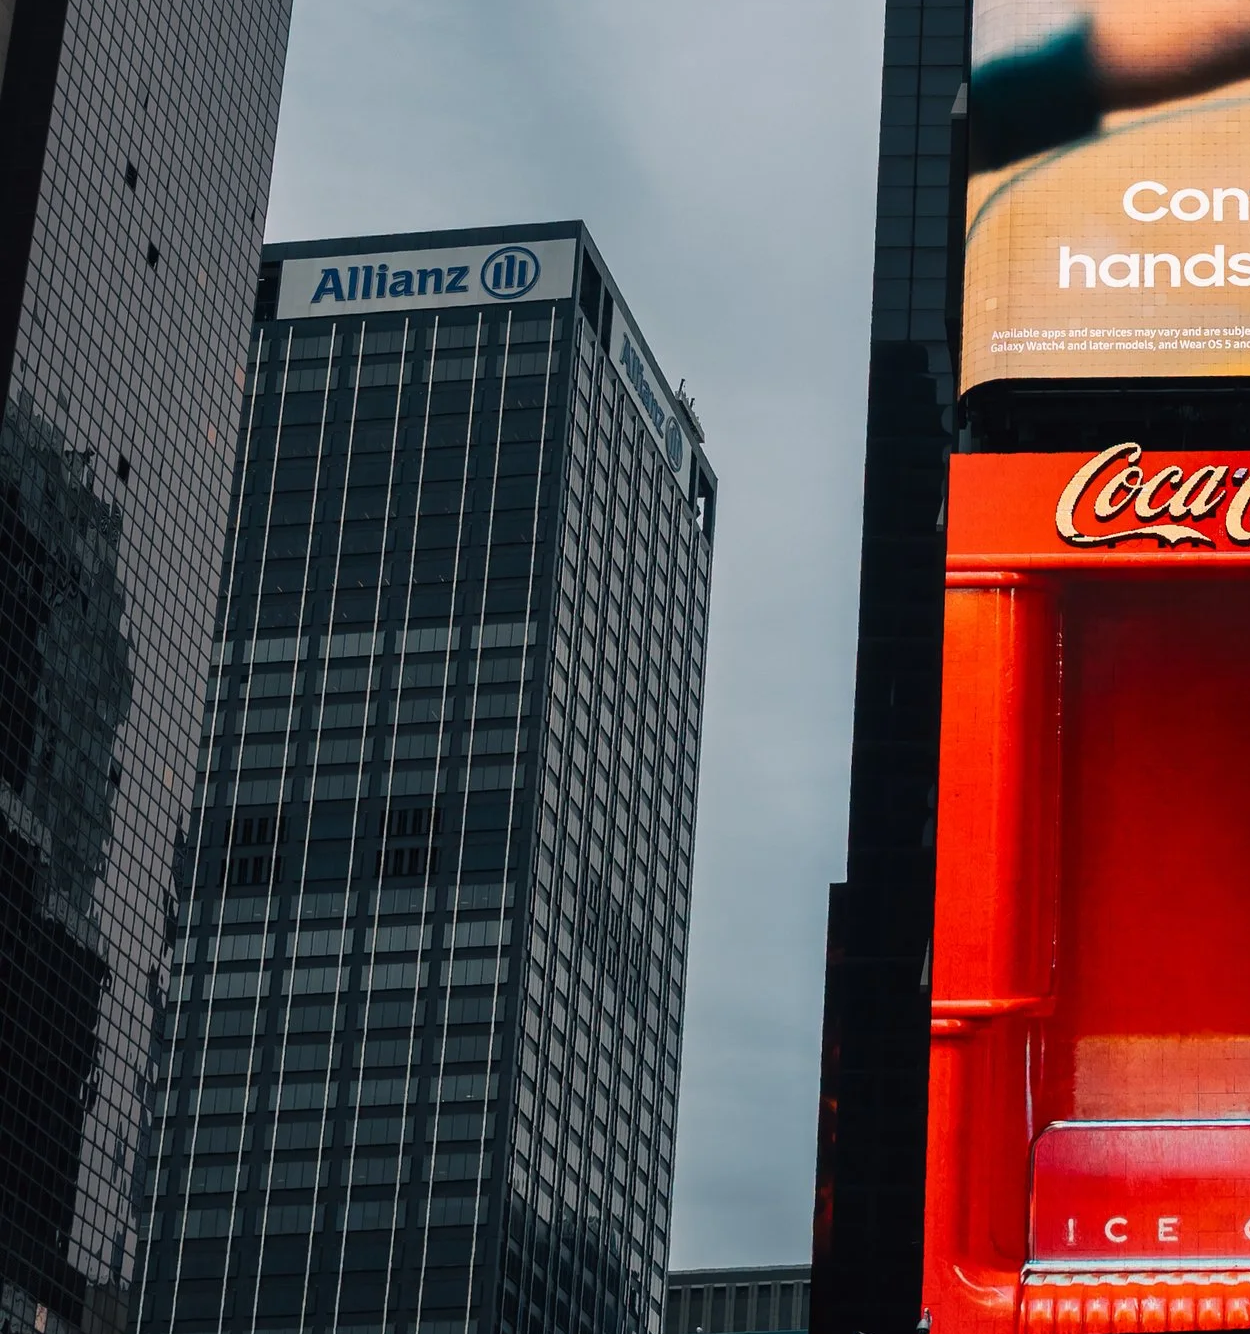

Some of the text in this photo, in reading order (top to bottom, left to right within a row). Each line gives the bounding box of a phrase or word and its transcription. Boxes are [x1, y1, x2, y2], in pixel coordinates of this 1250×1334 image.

[310, 262, 470, 303] Allianz
[992, 327, 1040, 340] Available
[1041, 329, 1066, 339] apps
[1068, 327, 1088, 338] and
[1089, 327, 1132, 337] services
[1135, 328, 1156, 338] may
[1158, 328, 1181, 339] vary
[1182, 326, 1202, 337] and
[1203, 328, 1222, 336] are
[991, 340, 1024, 353] Galaxy
[1026, 339, 1065, 351] Watch4
[1067, 339, 1087, 350] and
[1089, 339, 1114, 350] later
[1115, 339, 1157, 351] models,
[1158, 339, 1178, 350] and
[1179, 339, 1206, 349] Wear
[1208, 339, 1223, 349] OS
[1224, 339, 1231, 349] 5
[1067, 1217, 1180, 1243] ICE
